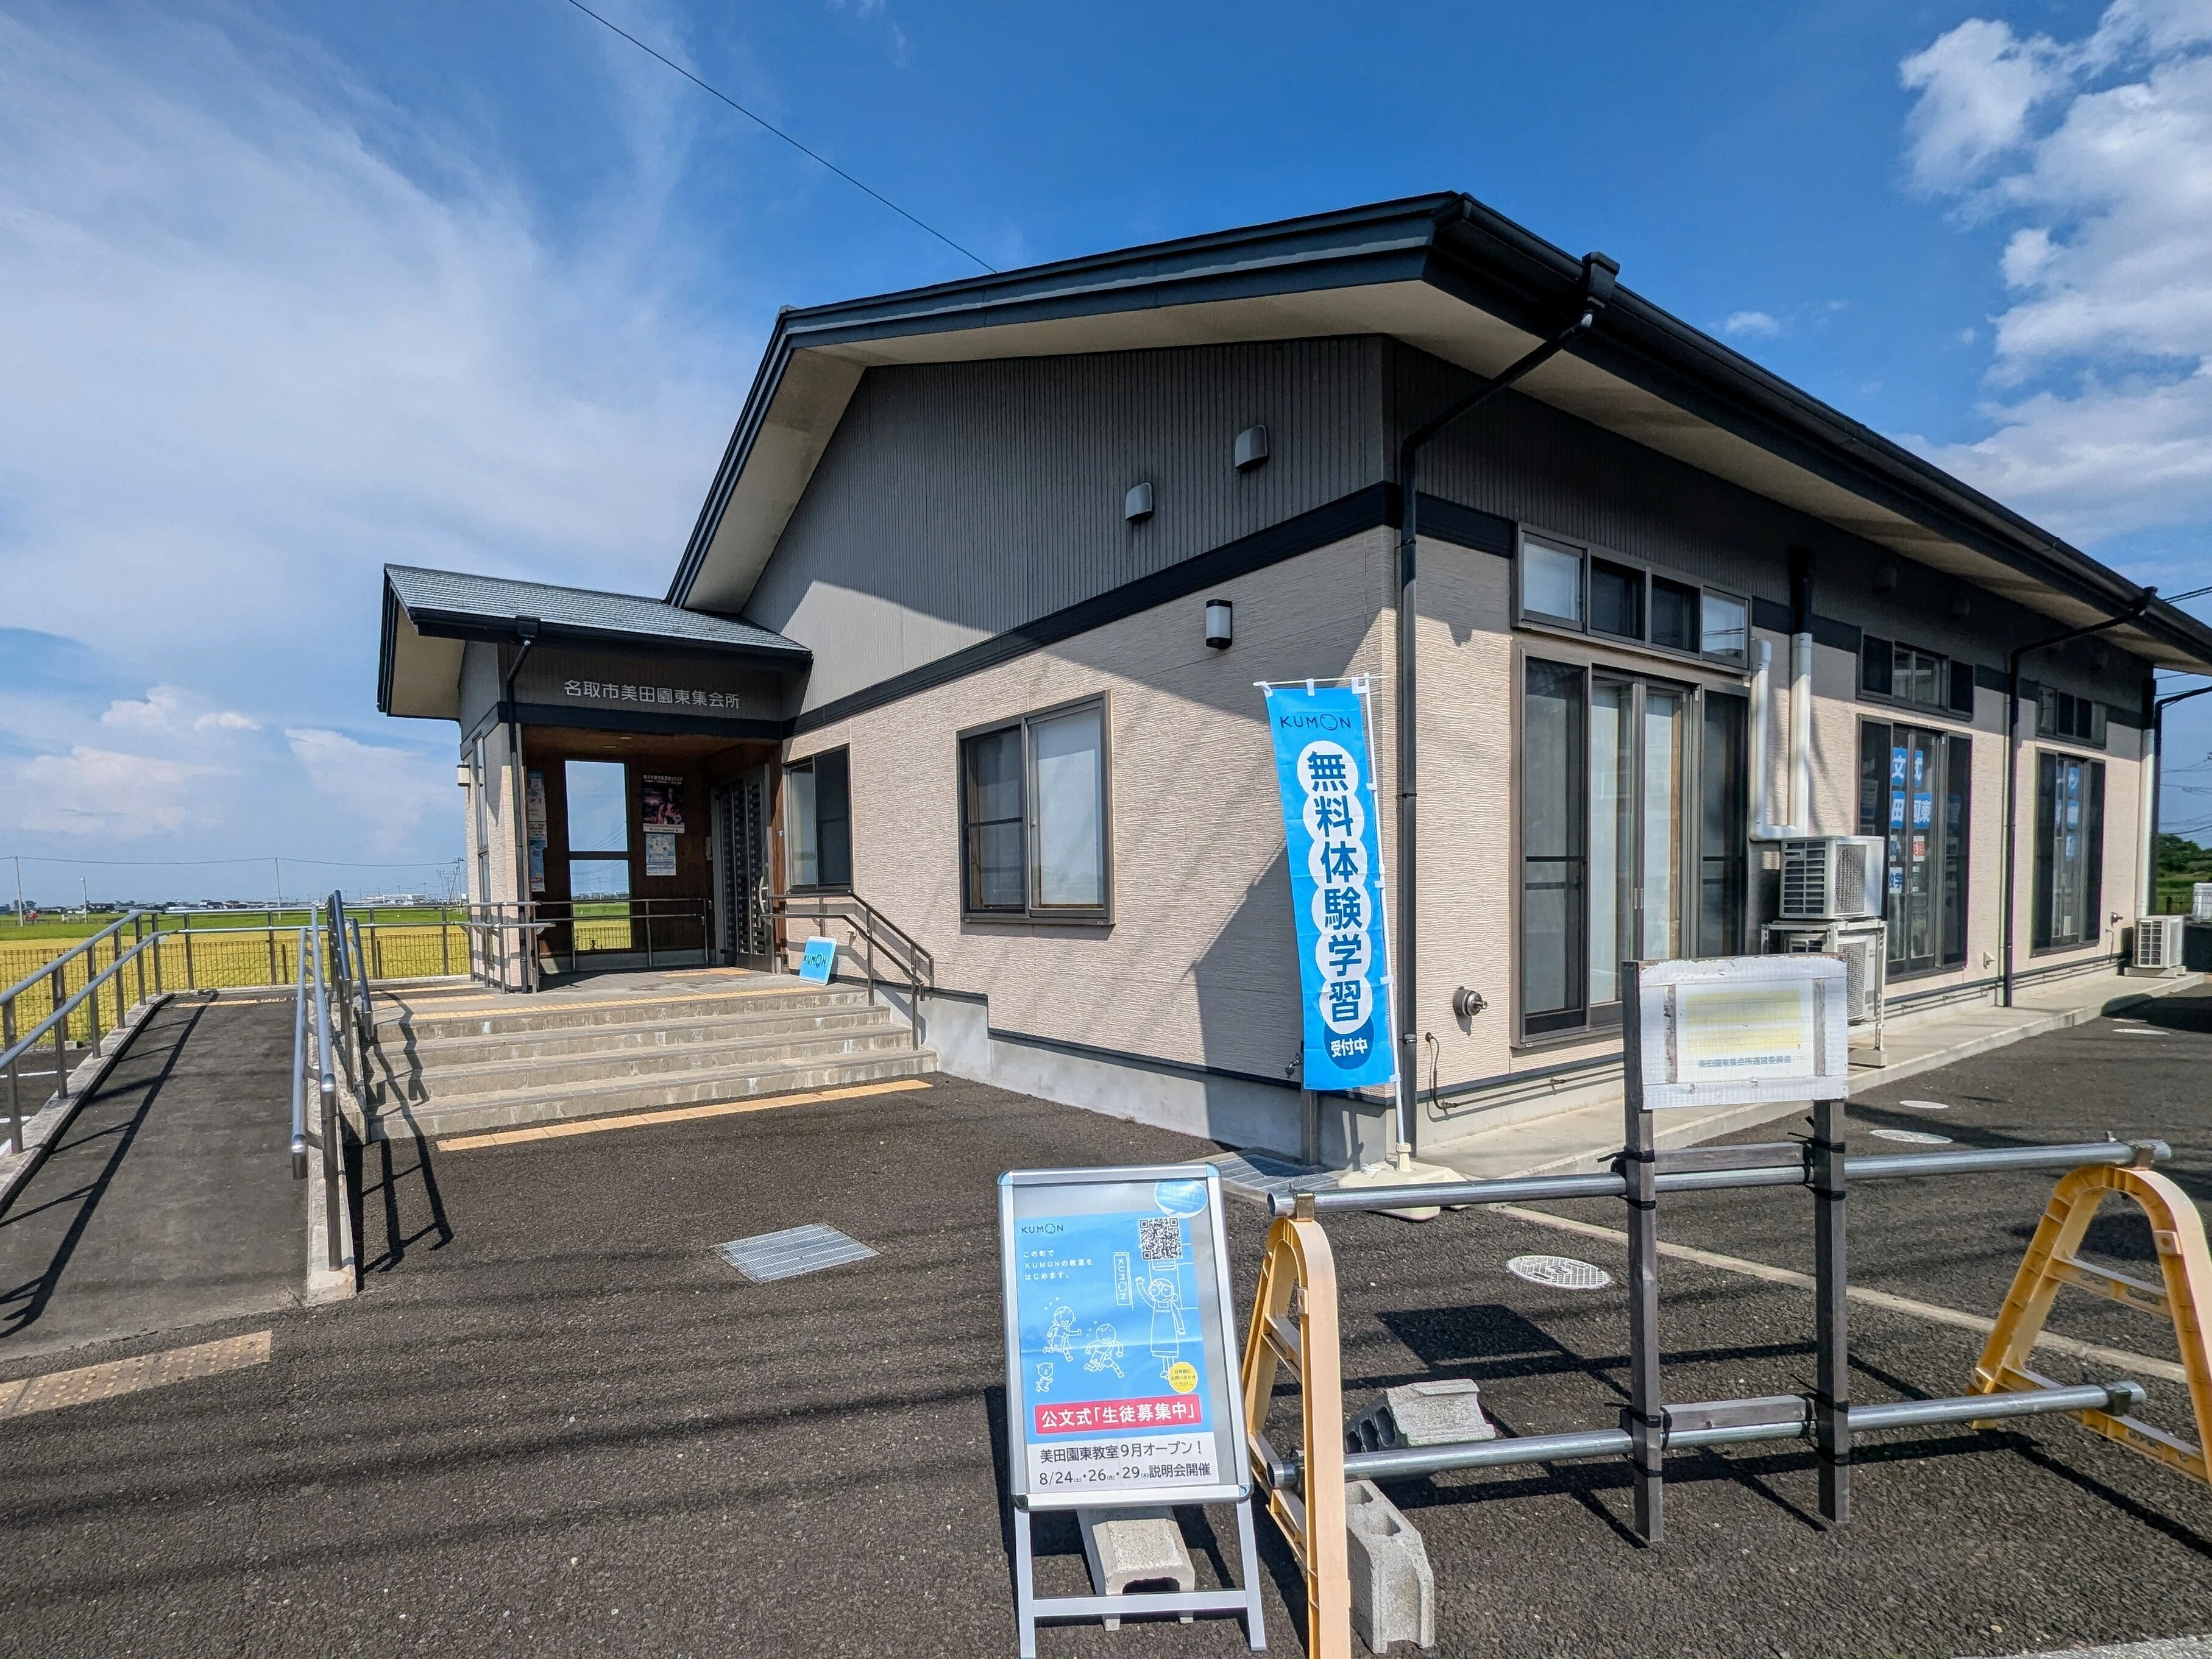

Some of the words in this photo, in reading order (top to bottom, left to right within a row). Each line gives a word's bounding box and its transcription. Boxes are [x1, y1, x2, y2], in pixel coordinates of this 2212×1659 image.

[564, 679, 740, 709] 名取市美田園東集会所
[1280, 713, 1352, 731] KUMON
[1306, 751, 1363, 1023] 無料体験学習
[803, 953, 828, 968] KUMON
[1330, 1037, 1368, 1058] 受付中
[1021, 1223, 1064, 1234] KUMON
[1024, 1258, 1093, 1269] KUMONの教室を
[1024, 1272, 1069, 1281] はじめます。
[1118, 1259, 1128, 1300] KUMON
[1041, 1401, 1195, 1429] 公文式「生徒募集中」
